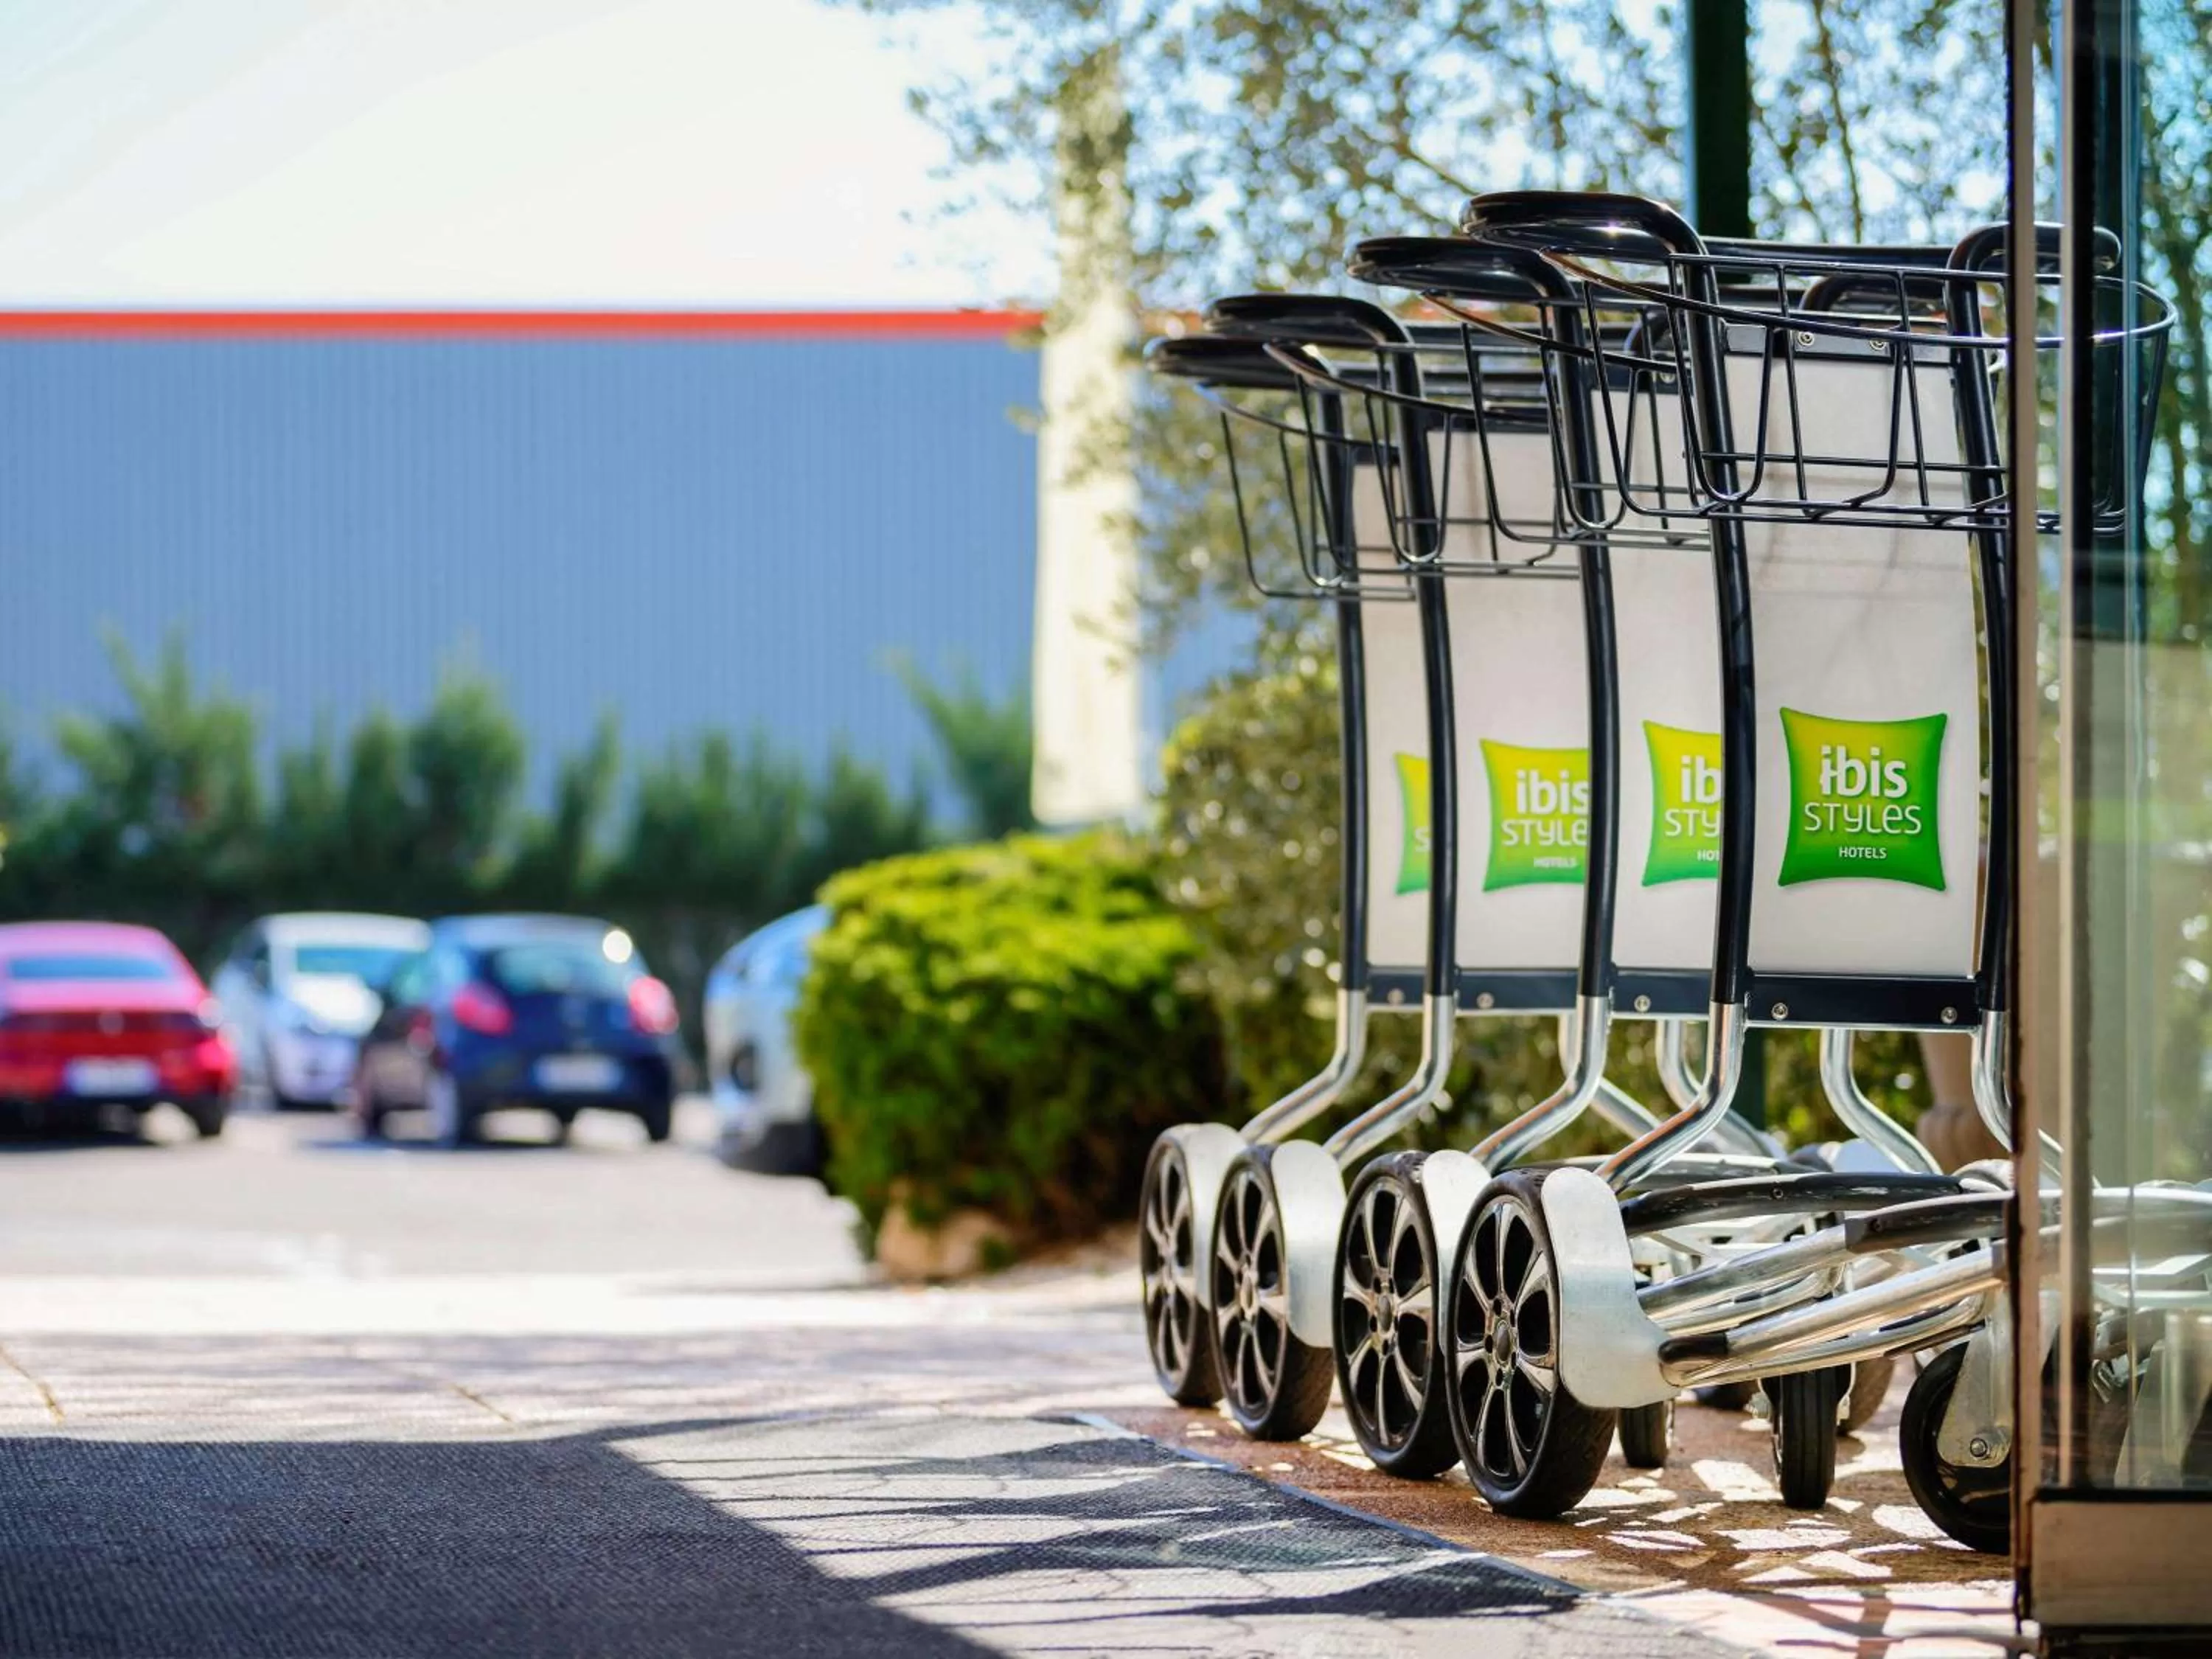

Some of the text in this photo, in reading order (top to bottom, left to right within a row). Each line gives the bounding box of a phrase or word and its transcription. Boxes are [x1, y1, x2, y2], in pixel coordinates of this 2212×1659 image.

[1681, 754, 1722, 804] ib
[1820, 745, 1907, 798] ibis
[1516, 769, 1590, 815] ibis
[1501, 819, 1589, 846] STYLE
[1665, 808, 1722, 838] STY
[1839, 846, 1888, 859] HOTELS
